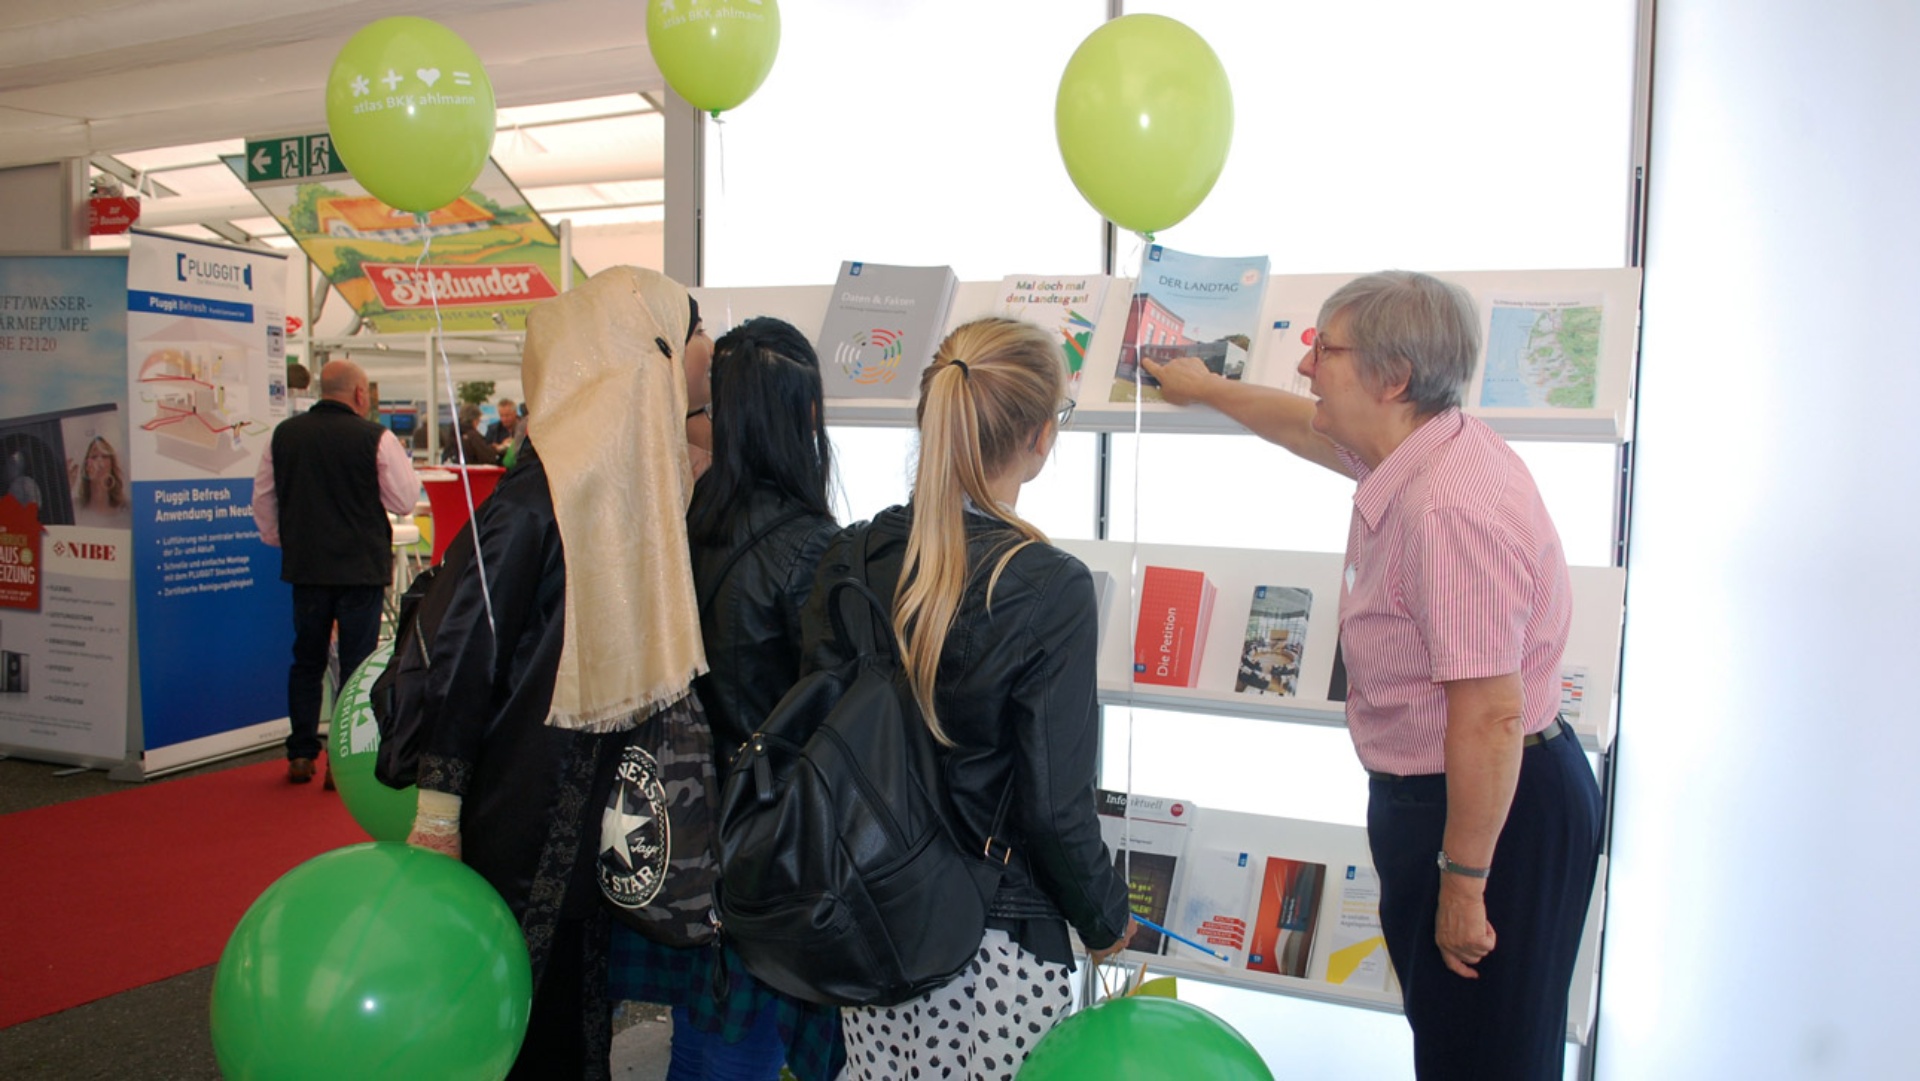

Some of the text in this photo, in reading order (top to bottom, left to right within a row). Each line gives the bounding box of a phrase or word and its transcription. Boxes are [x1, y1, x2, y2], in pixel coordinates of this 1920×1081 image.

[353, 93, 476, 115] atlas BKK ahlmann
[188, 259, 240, 281] PLUGGIT
[381, 267, 531, 304] Böklunder
[1016, 280, 1086, 291] Mal doch mal
[1159, 275, 1239, 293] DER LANDTAG
[0, 295, 92, 311] FT/WASSER-
[150, 296, 178, 311] Pluggit
[841, 291, 871, 304] Daten
[884, 295, 915, 307] Fakten
[1006, 293, 1089, 306] den Landtag an!
[20, 336, 57, 352] F2120
[155, 488, 231, 505] Pluggit Befresh
[156, 504, 254, 522] Anwendung im Neub
[68, 542, 116, 561] NIBE
[1156, 607, 1176, 677] Die Petition
[613, 865, 654, 894] STAR
